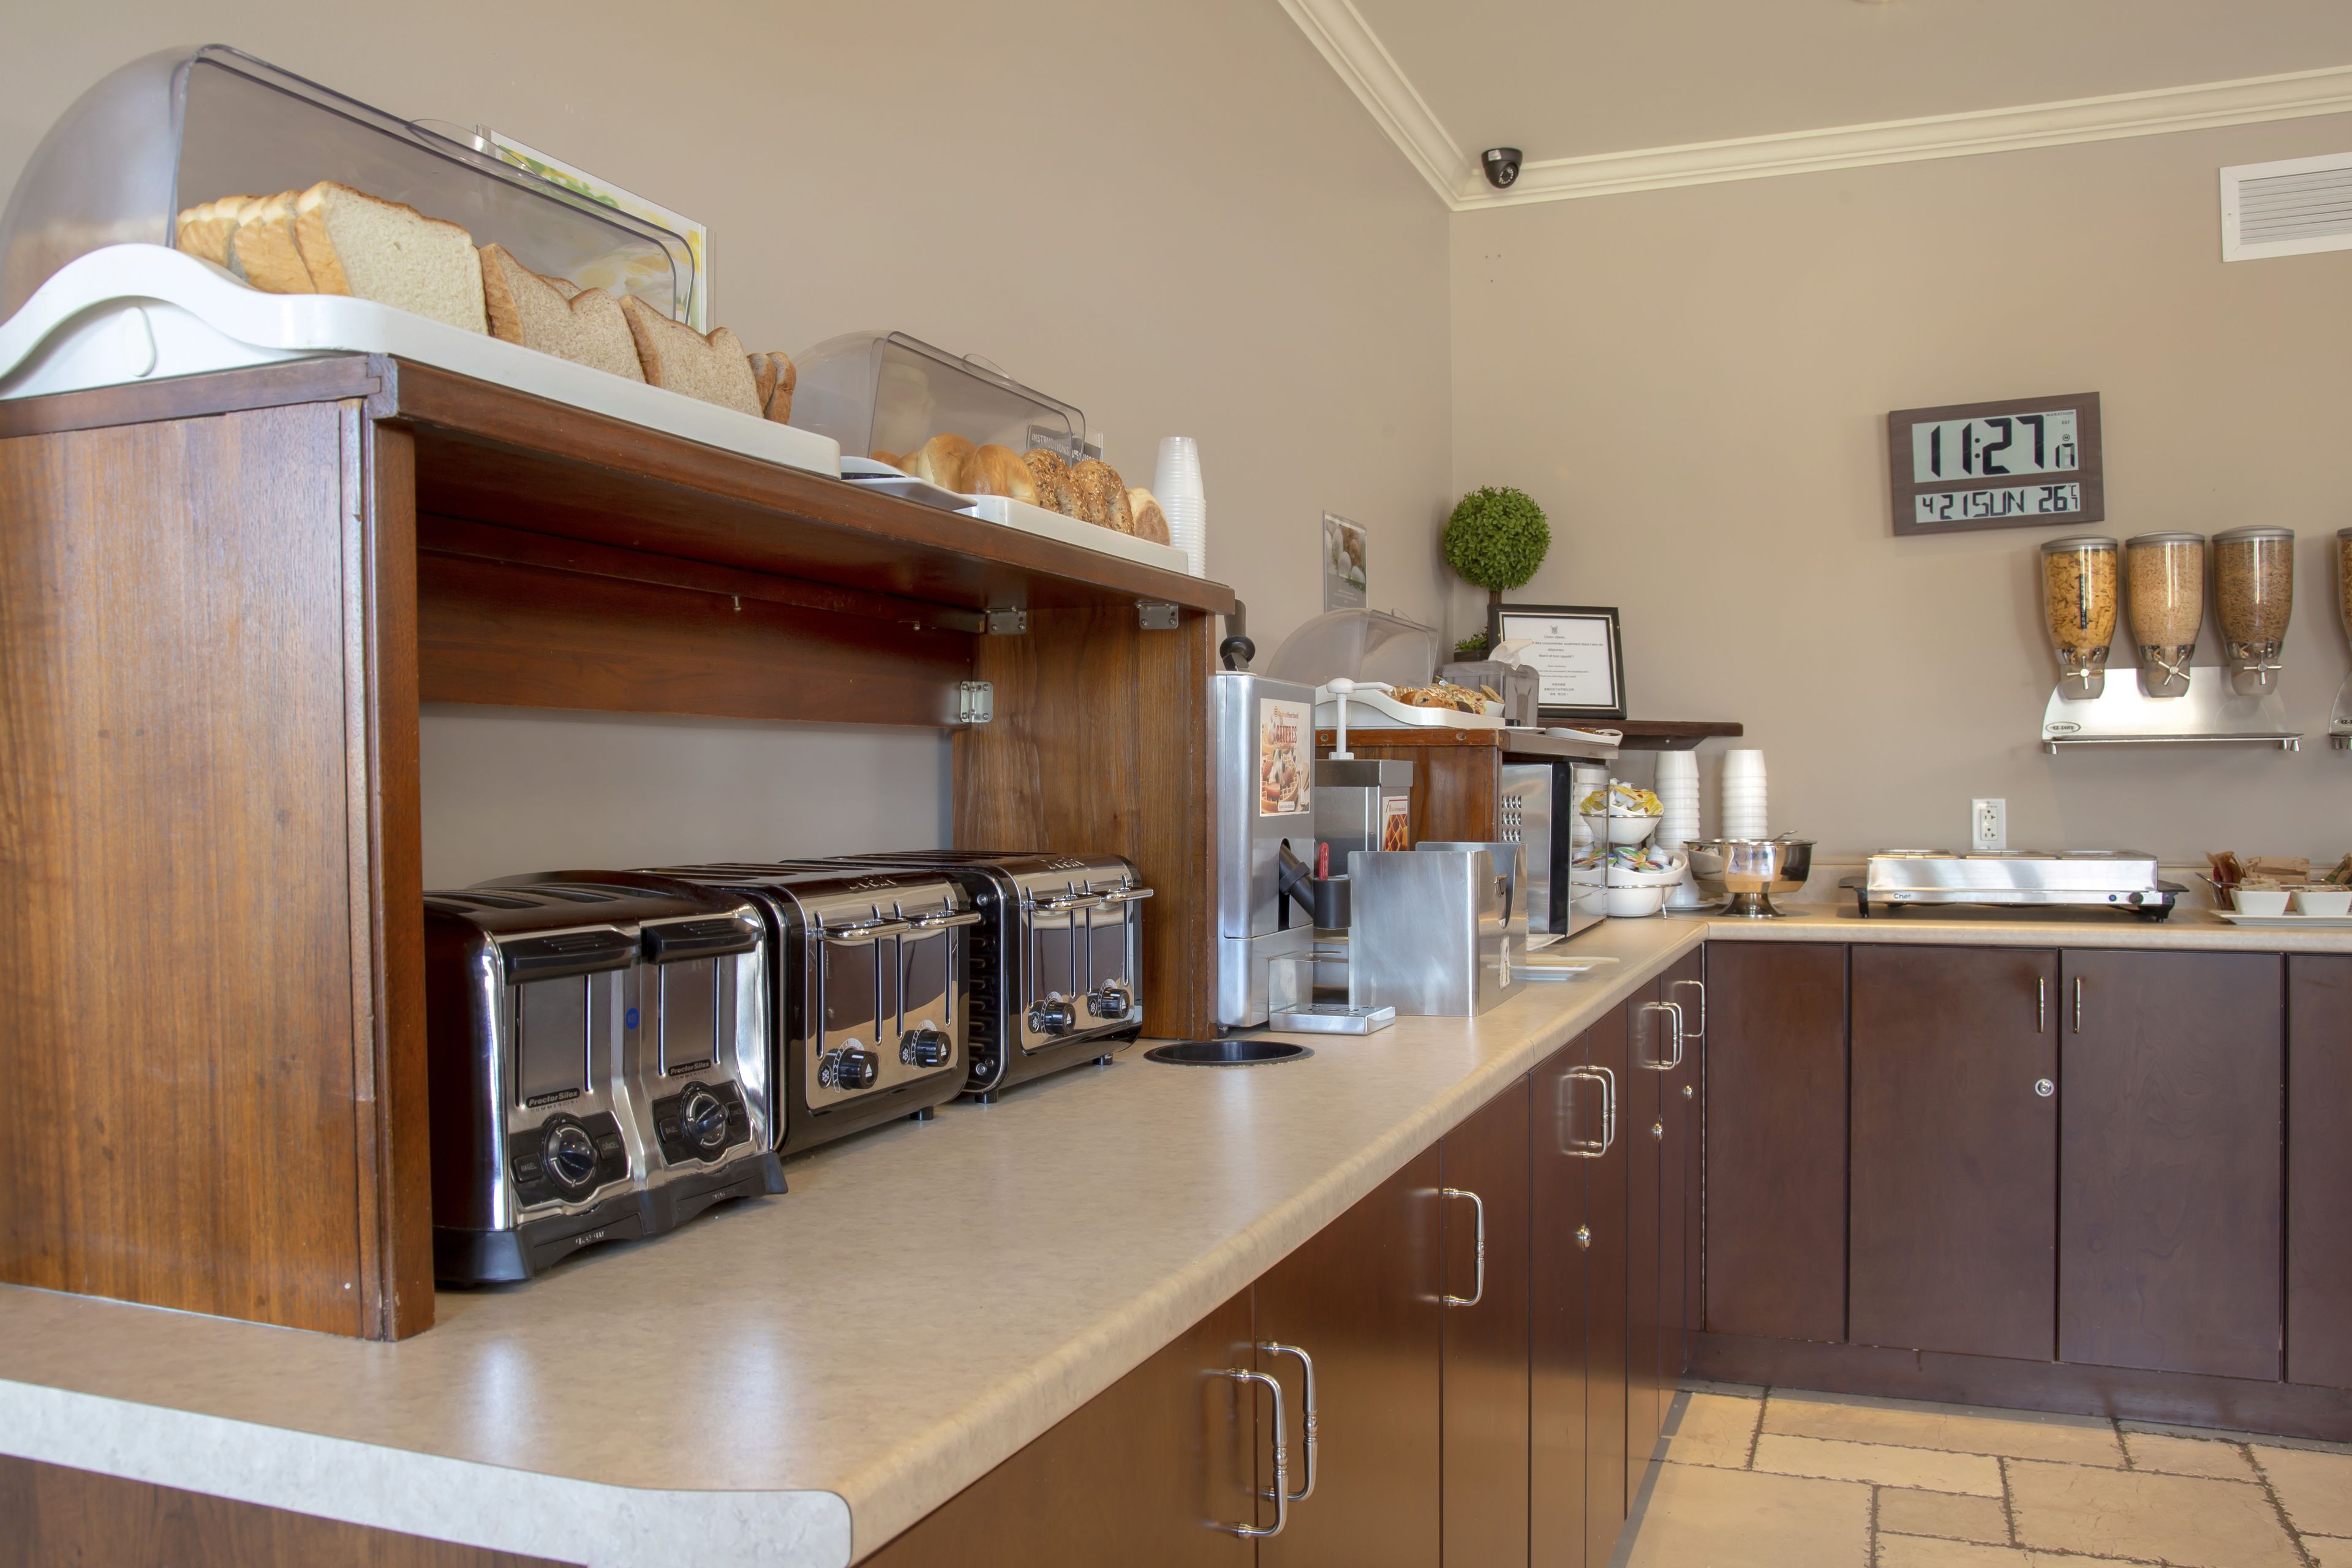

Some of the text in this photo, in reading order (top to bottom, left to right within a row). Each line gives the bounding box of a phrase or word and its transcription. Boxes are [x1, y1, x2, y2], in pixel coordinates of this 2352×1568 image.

[1931, 415, 2044, 478] 11:27
[1972, 489, 2024, 518] SUN
[1276, 725, 1297, 744] GAUFRES
[530, 1100, 579, 1113] COMMERCIAL
